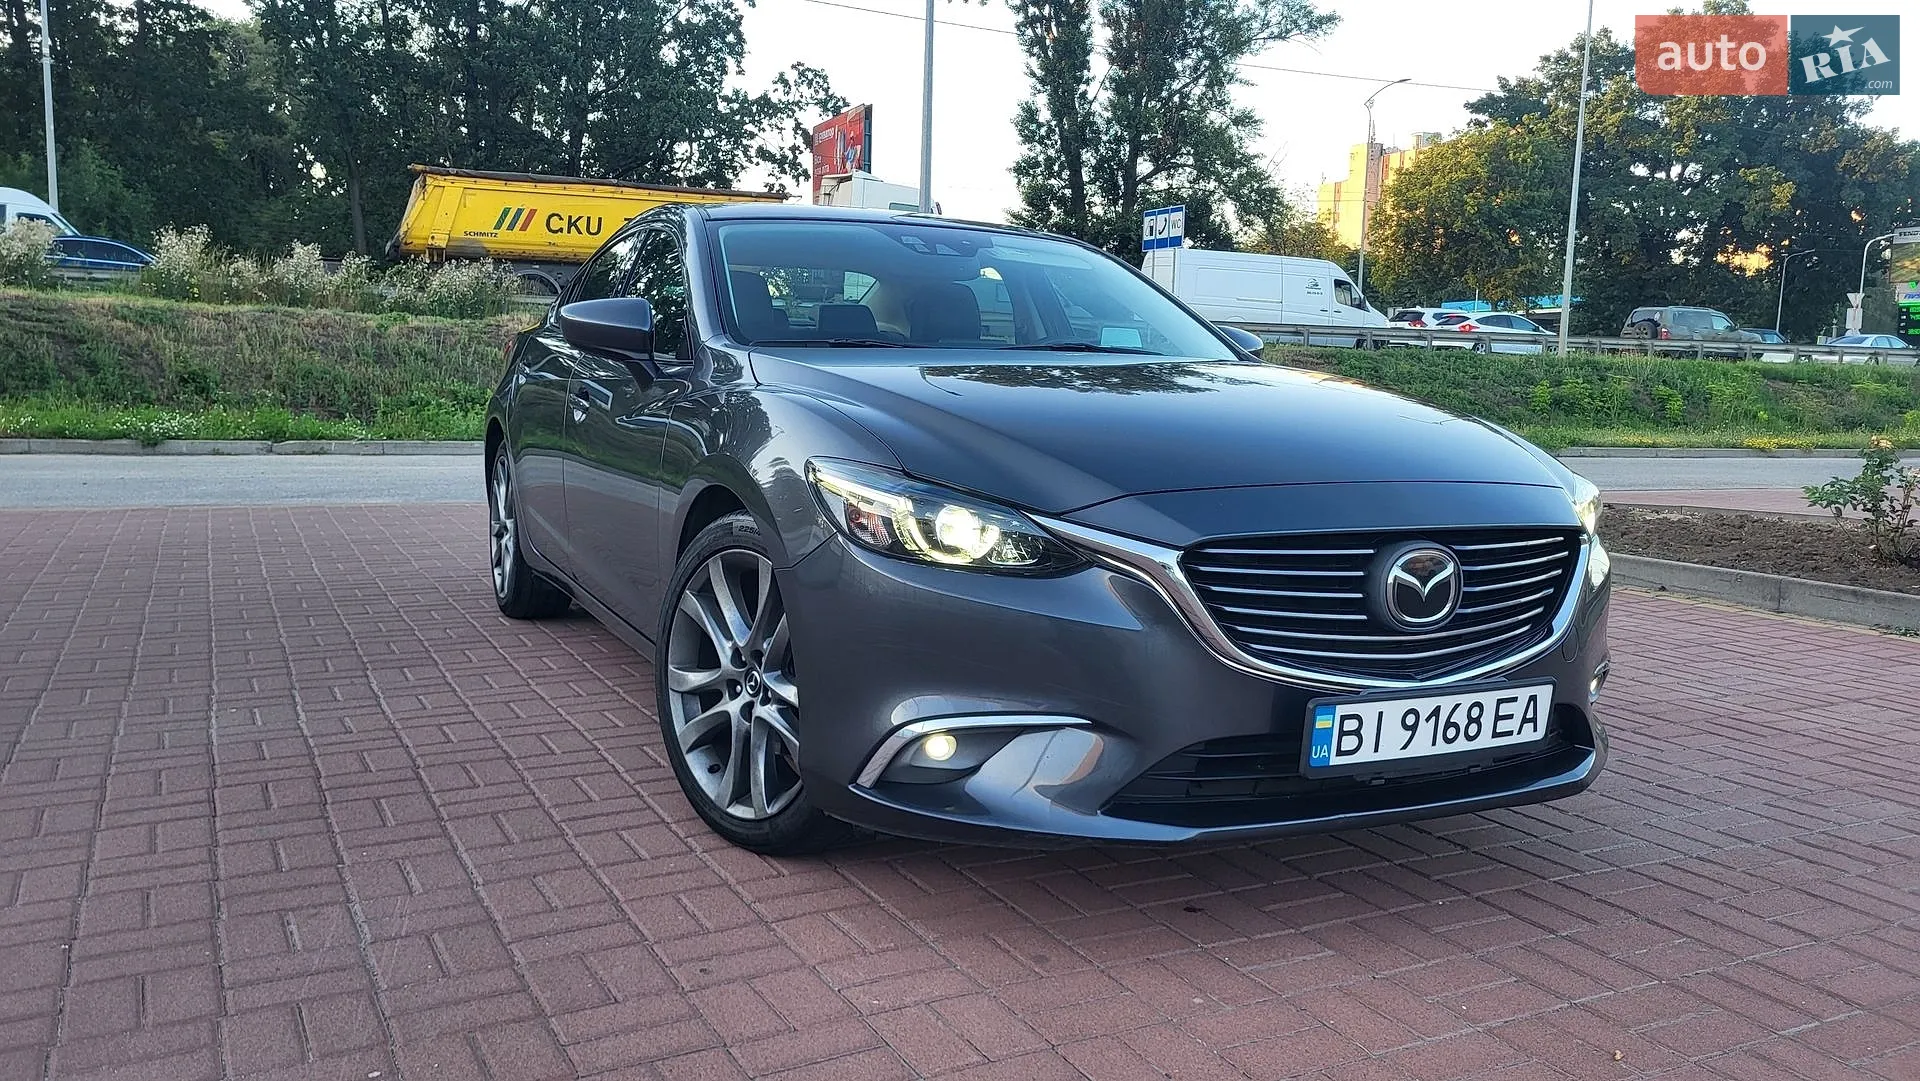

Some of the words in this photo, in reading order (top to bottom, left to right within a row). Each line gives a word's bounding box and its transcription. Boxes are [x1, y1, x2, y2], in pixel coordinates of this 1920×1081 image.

[1171, 218, 1182, 230] WC
[463, 230, 499, 239] SCHMITZ
[1335, 711, 1384, 757] BI
[1399, 700, 1485, 751] 9168
[1491, 694, 1538, 739] EA
[1311, 744, 1329, 759] UA
